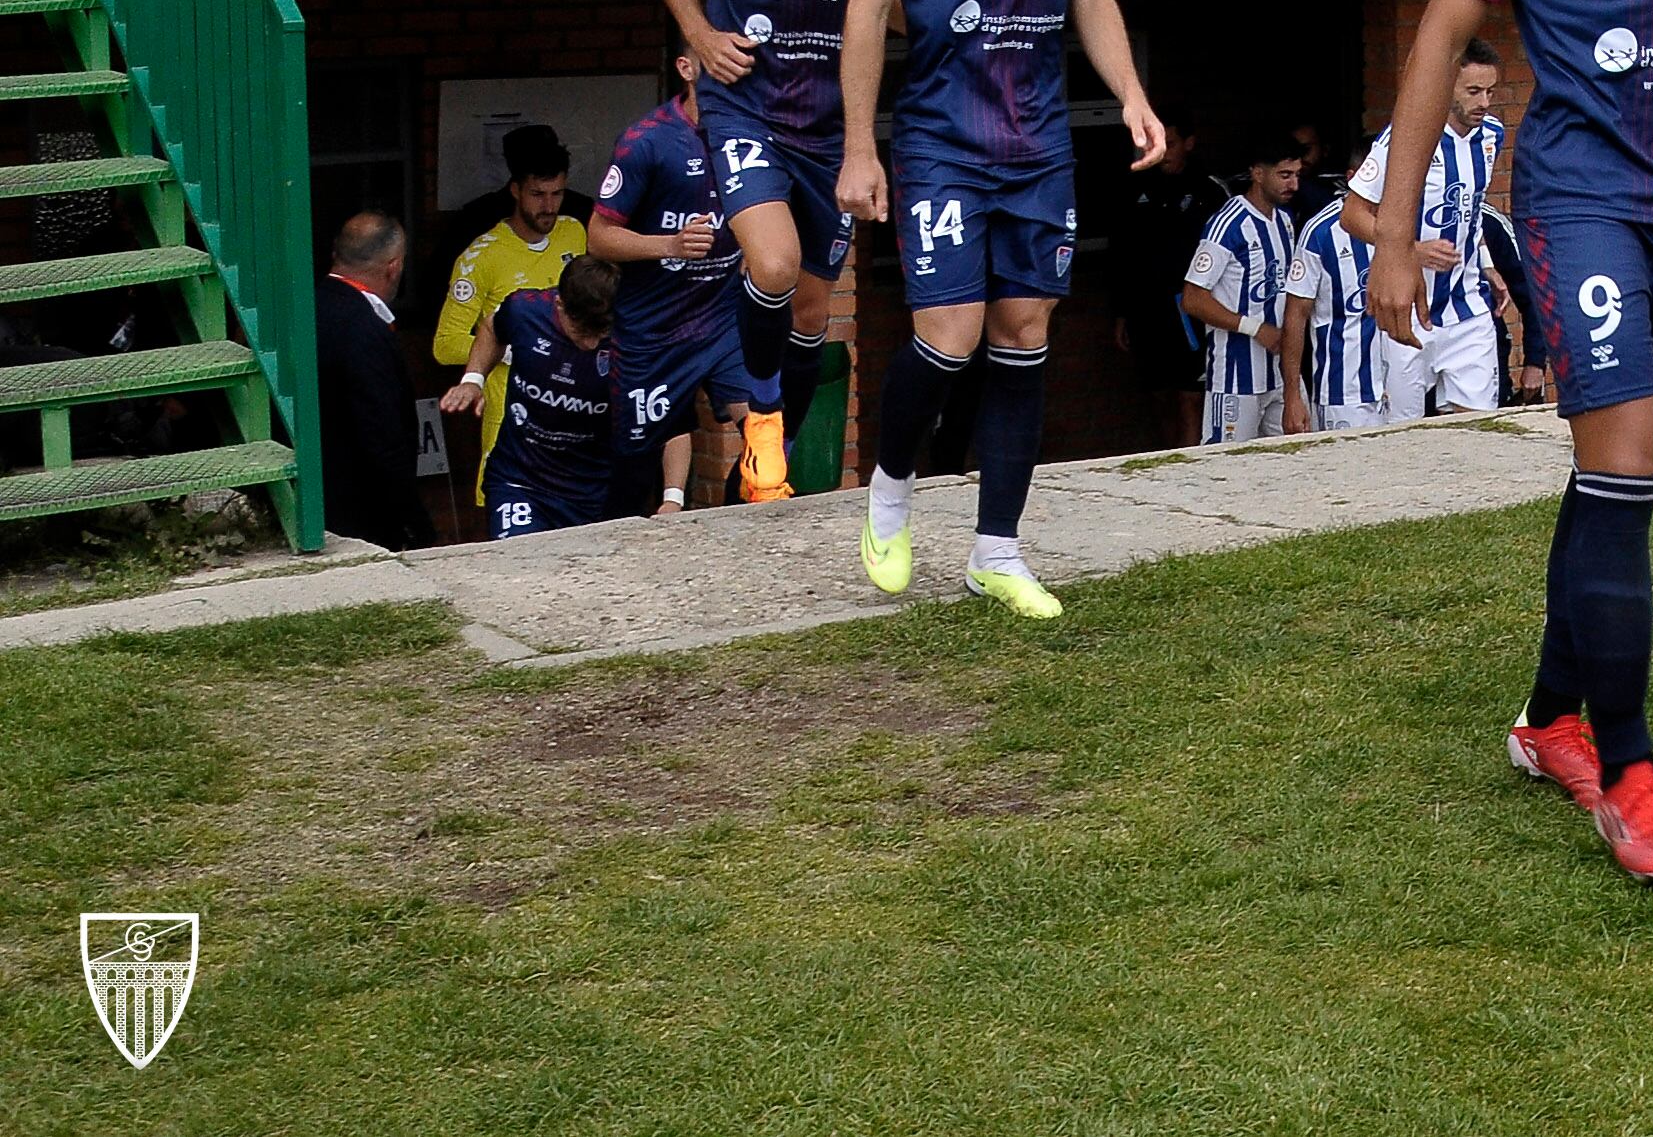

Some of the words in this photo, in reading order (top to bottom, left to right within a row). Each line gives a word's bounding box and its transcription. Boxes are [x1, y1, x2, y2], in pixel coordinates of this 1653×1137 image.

[721, 138, 770, 174] 12
[911, 199, 964, 252] 14
[1578, 275, 1622, 342] 9
[628, 384, 671, 425] 16
[497, 502, 532, 529] 18
